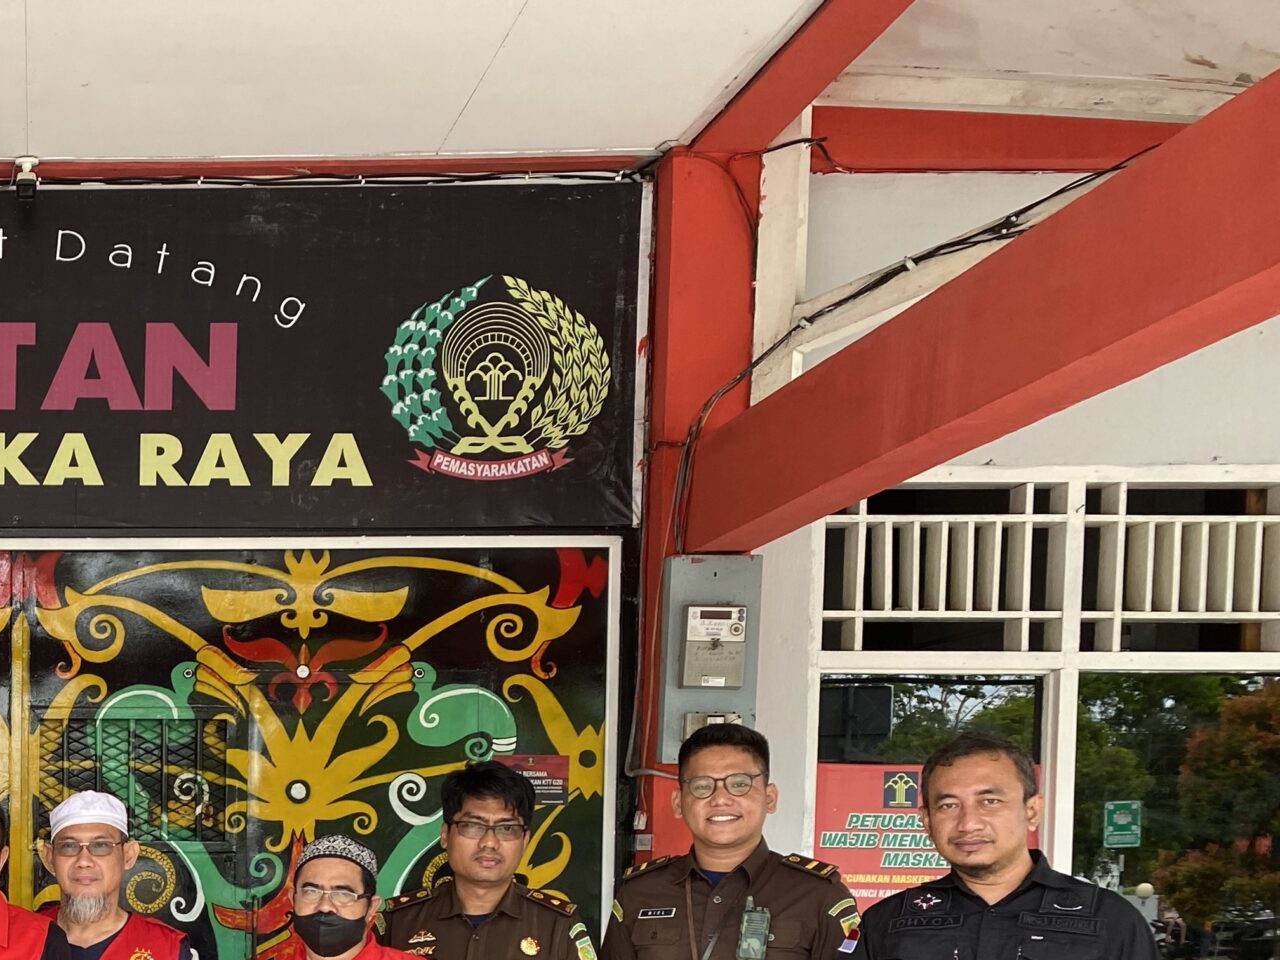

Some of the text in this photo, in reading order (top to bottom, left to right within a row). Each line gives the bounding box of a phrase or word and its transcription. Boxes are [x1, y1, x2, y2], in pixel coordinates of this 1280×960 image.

[55, 229, 306, 329] Datang
[139, 433, 373, 487] RAYA
[433, 452, 550, 477] PEMASYARAKATAN
[820, 831, 879, 848] WAJIB
[881, 851, 951, 868] MASKE
